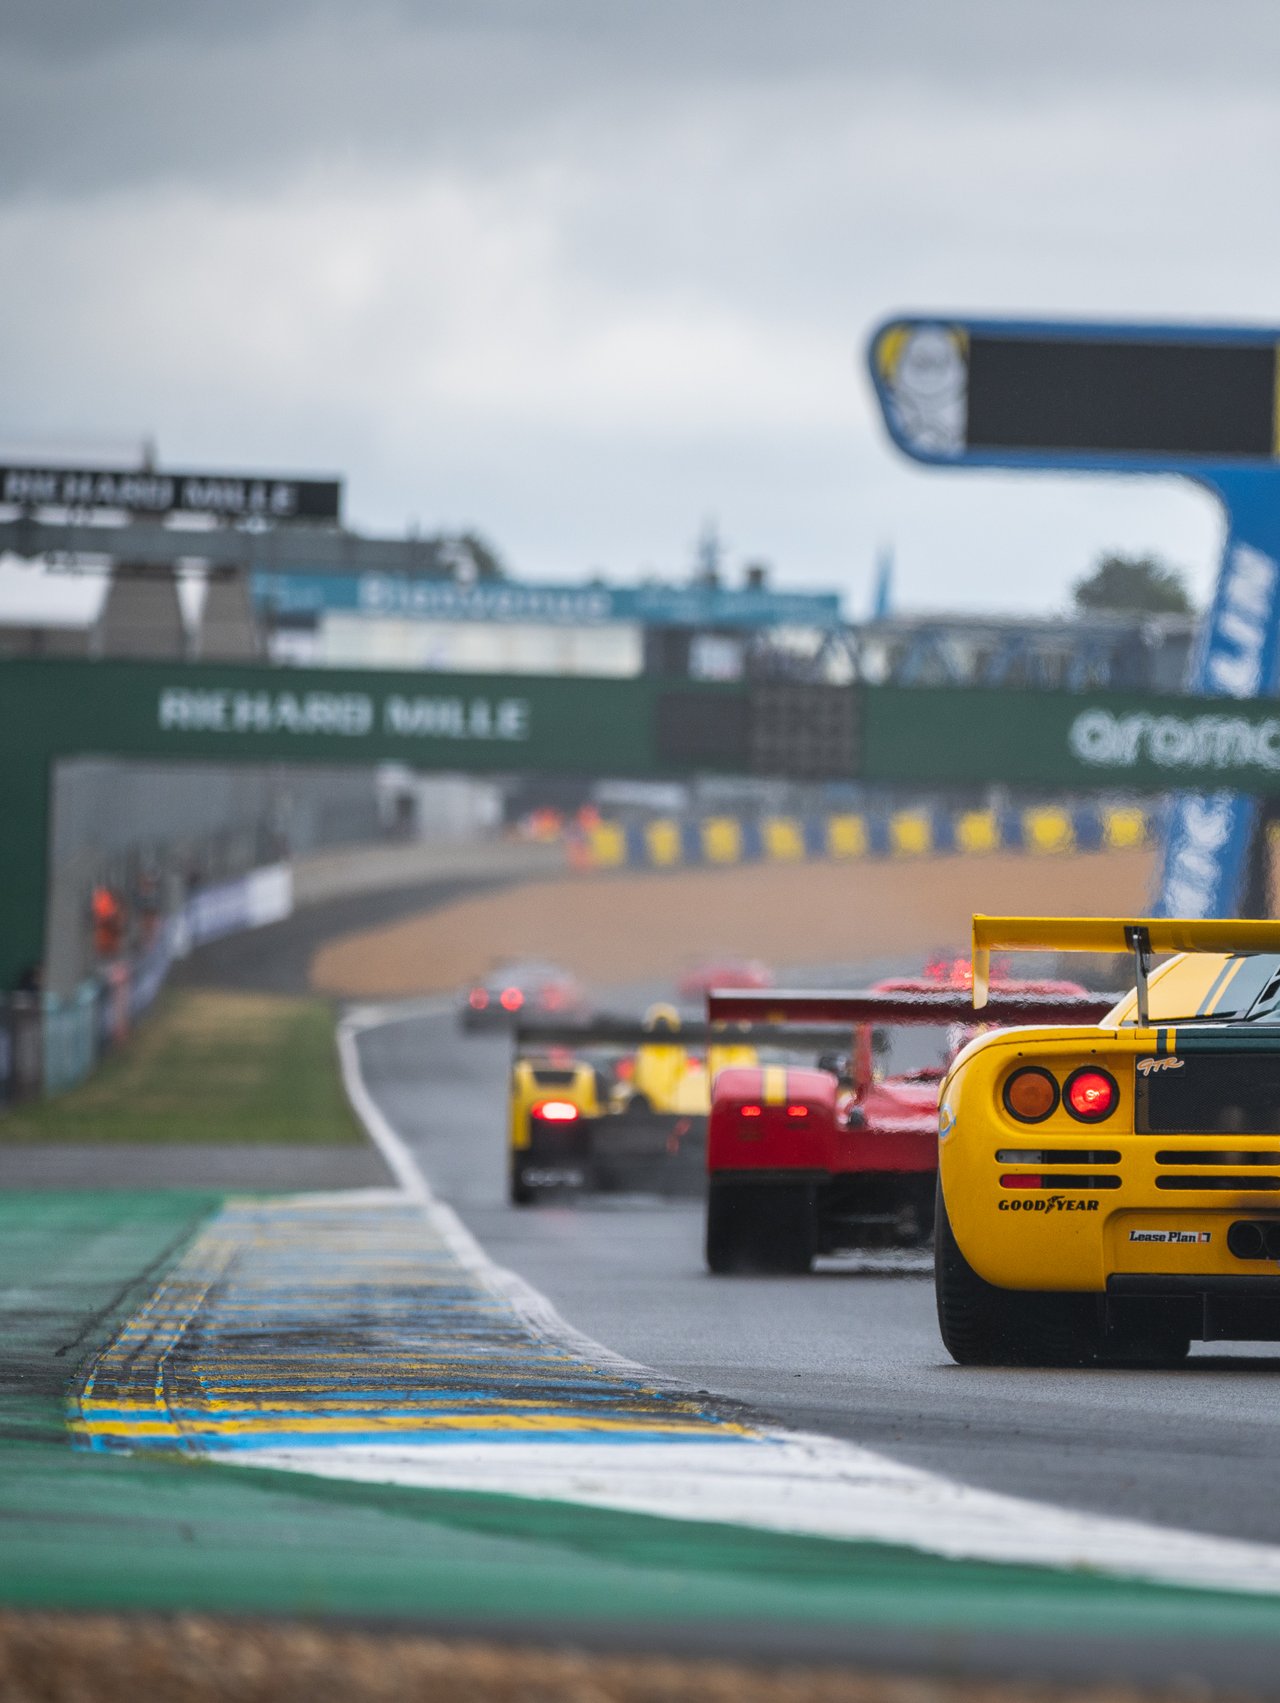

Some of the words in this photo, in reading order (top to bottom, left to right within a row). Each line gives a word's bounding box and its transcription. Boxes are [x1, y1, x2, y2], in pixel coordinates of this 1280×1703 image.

[4, 471, 174, 508] RICHARD
[182, 480, 295, 515] MILLE
[159, 687, 375, 736] RICHARD
[383, 694, 530, 741] MILLE
[1137, 1057, 1185, 1076] GTR
[1129, 1231, 1166, 1242] Lease
[1168, 1232, 1196, 1243] Plan
